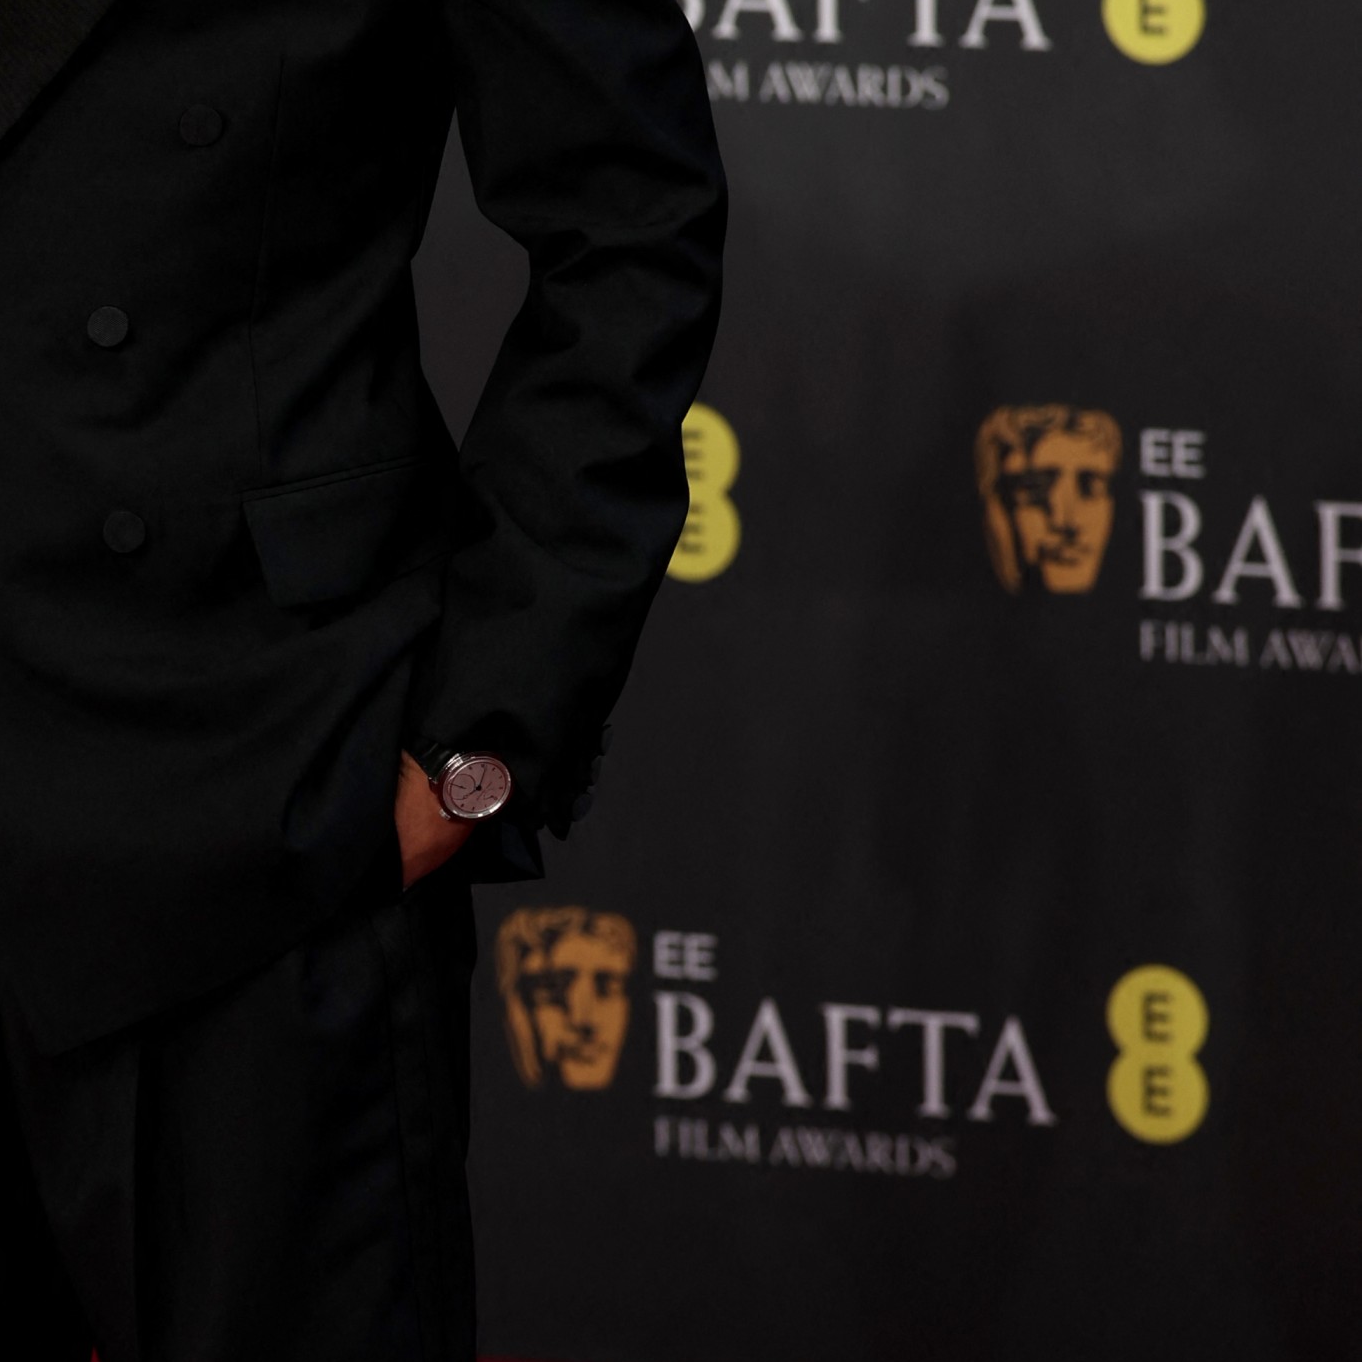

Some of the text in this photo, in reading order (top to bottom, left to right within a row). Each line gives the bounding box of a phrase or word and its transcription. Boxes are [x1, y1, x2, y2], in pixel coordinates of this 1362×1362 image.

[758, 62, 950, 107] AWARDS
[1139, 428, 1205, 479] EE
[1138, 620, 1362, 673] FILM AWA
[652, 930, 716, 981] EE
[655, 992, 1054, 1125] BAFTA
[653, 1116, 955, 1175] FILM AWARDS
